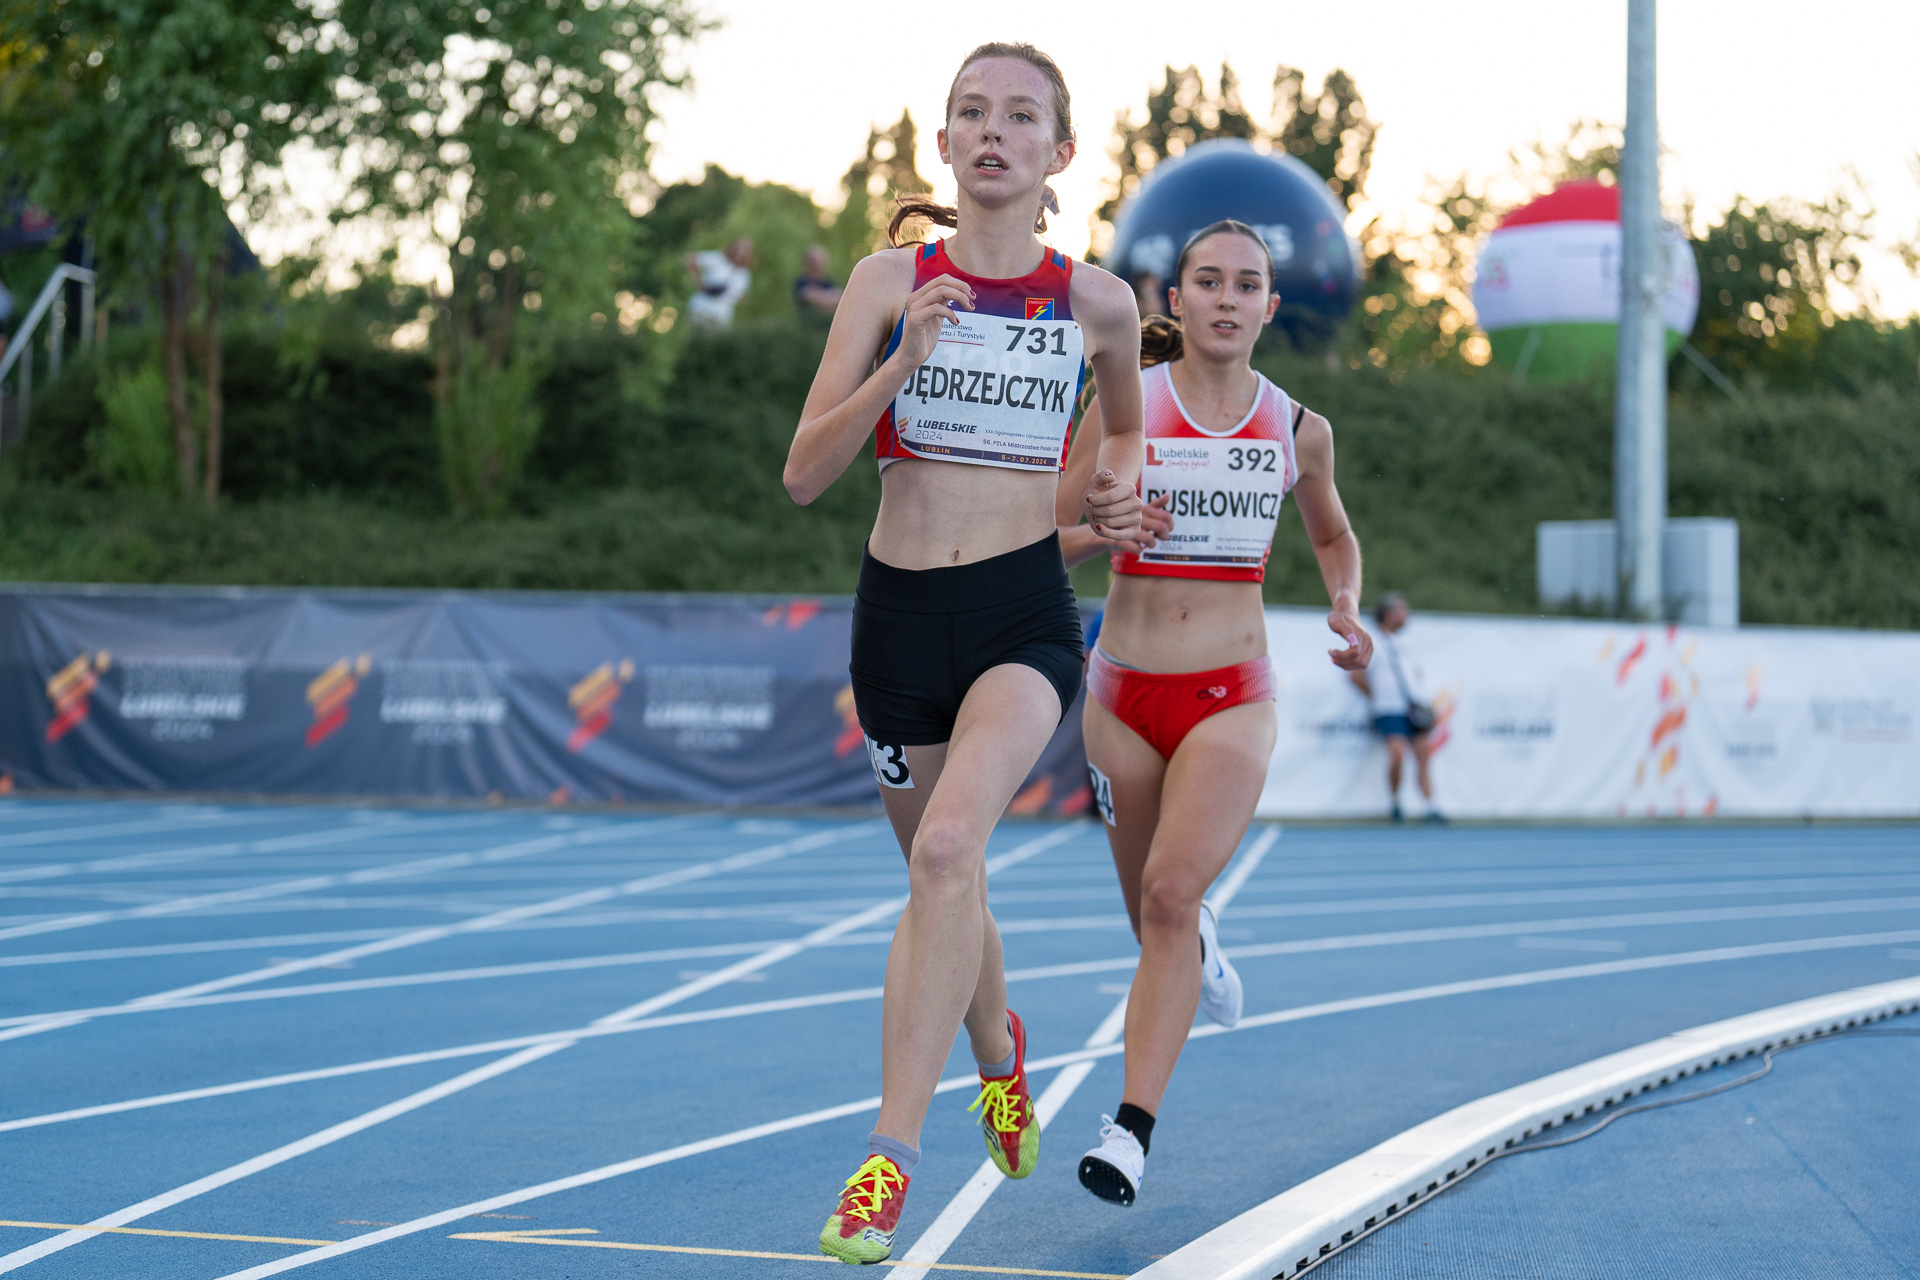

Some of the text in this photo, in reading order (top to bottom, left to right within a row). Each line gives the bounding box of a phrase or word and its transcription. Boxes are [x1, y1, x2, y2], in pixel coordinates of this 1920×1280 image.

[941, 322, 973, 331] nisterstwo
[957, 331, 985, 340] Turystyki
[1006, 324, 1067, 356] 731
[903, 364, 1069, 413] JĘDRZEJCZYK
[917, 419, 978, 434] LUBELSKIE
[914, 429, 943, 441] 2024
[920, 445, 951, 454] LUBLIN
[1008, 442, 1039, 451] Mistrzostwa
[1159, 447, 1209, 459] lubelskie
[1227, 447, 1276, 472] 392
[1167, 534, 1210, 543] UBELSKIE
